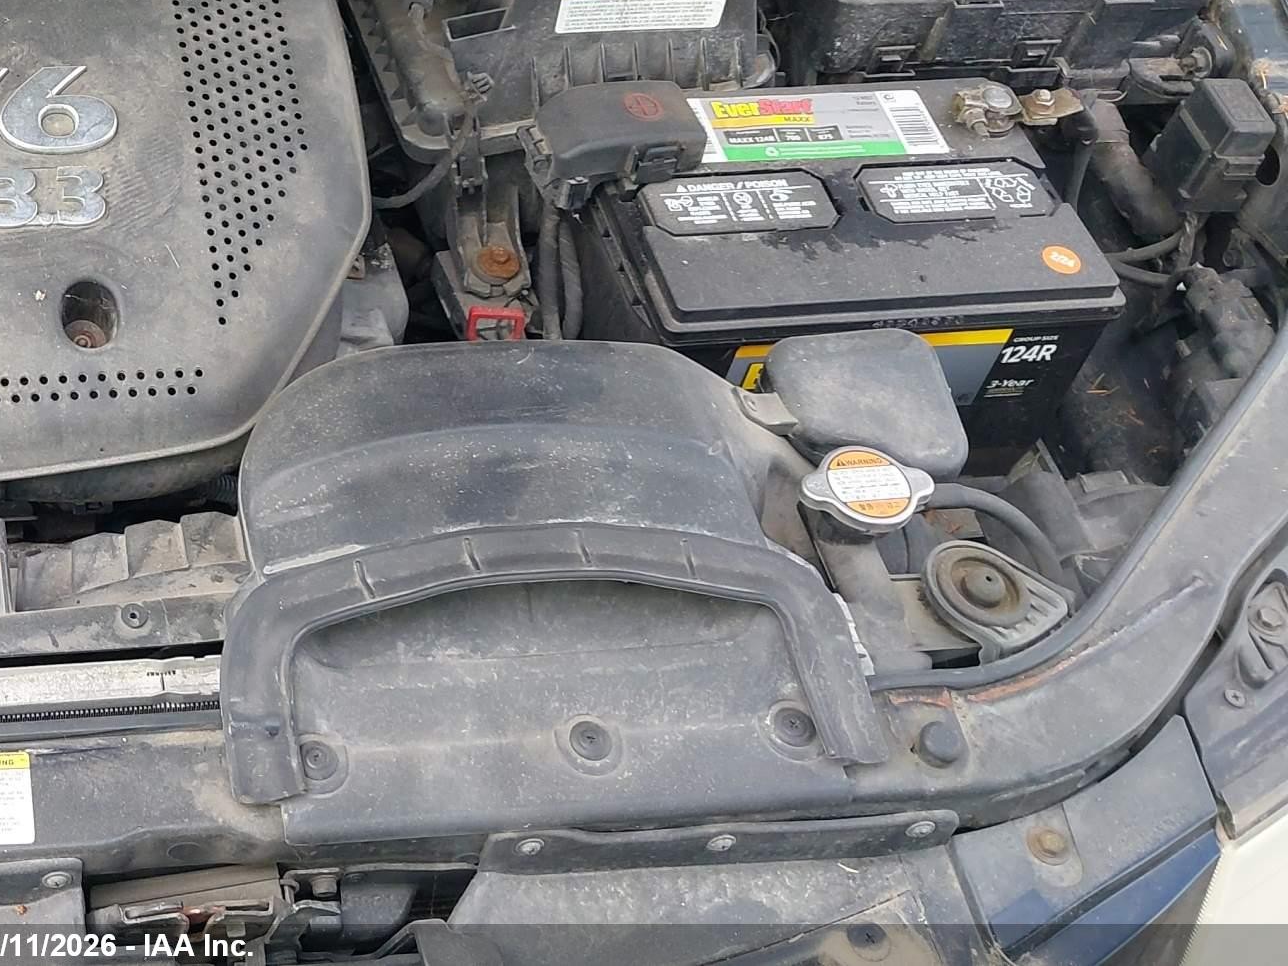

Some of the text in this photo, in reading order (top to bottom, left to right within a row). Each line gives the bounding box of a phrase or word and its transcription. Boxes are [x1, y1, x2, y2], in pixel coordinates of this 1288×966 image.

[711, 98, 814, 119] EverStart
[686, 181, 735, 192] DANGER
[745, 179, 789, 189] POISON
[1000, 344, 1058, 364] 124R
[986, 378, 1035, 389] 3-Year
[845, 458, 883, 466] WARNING
